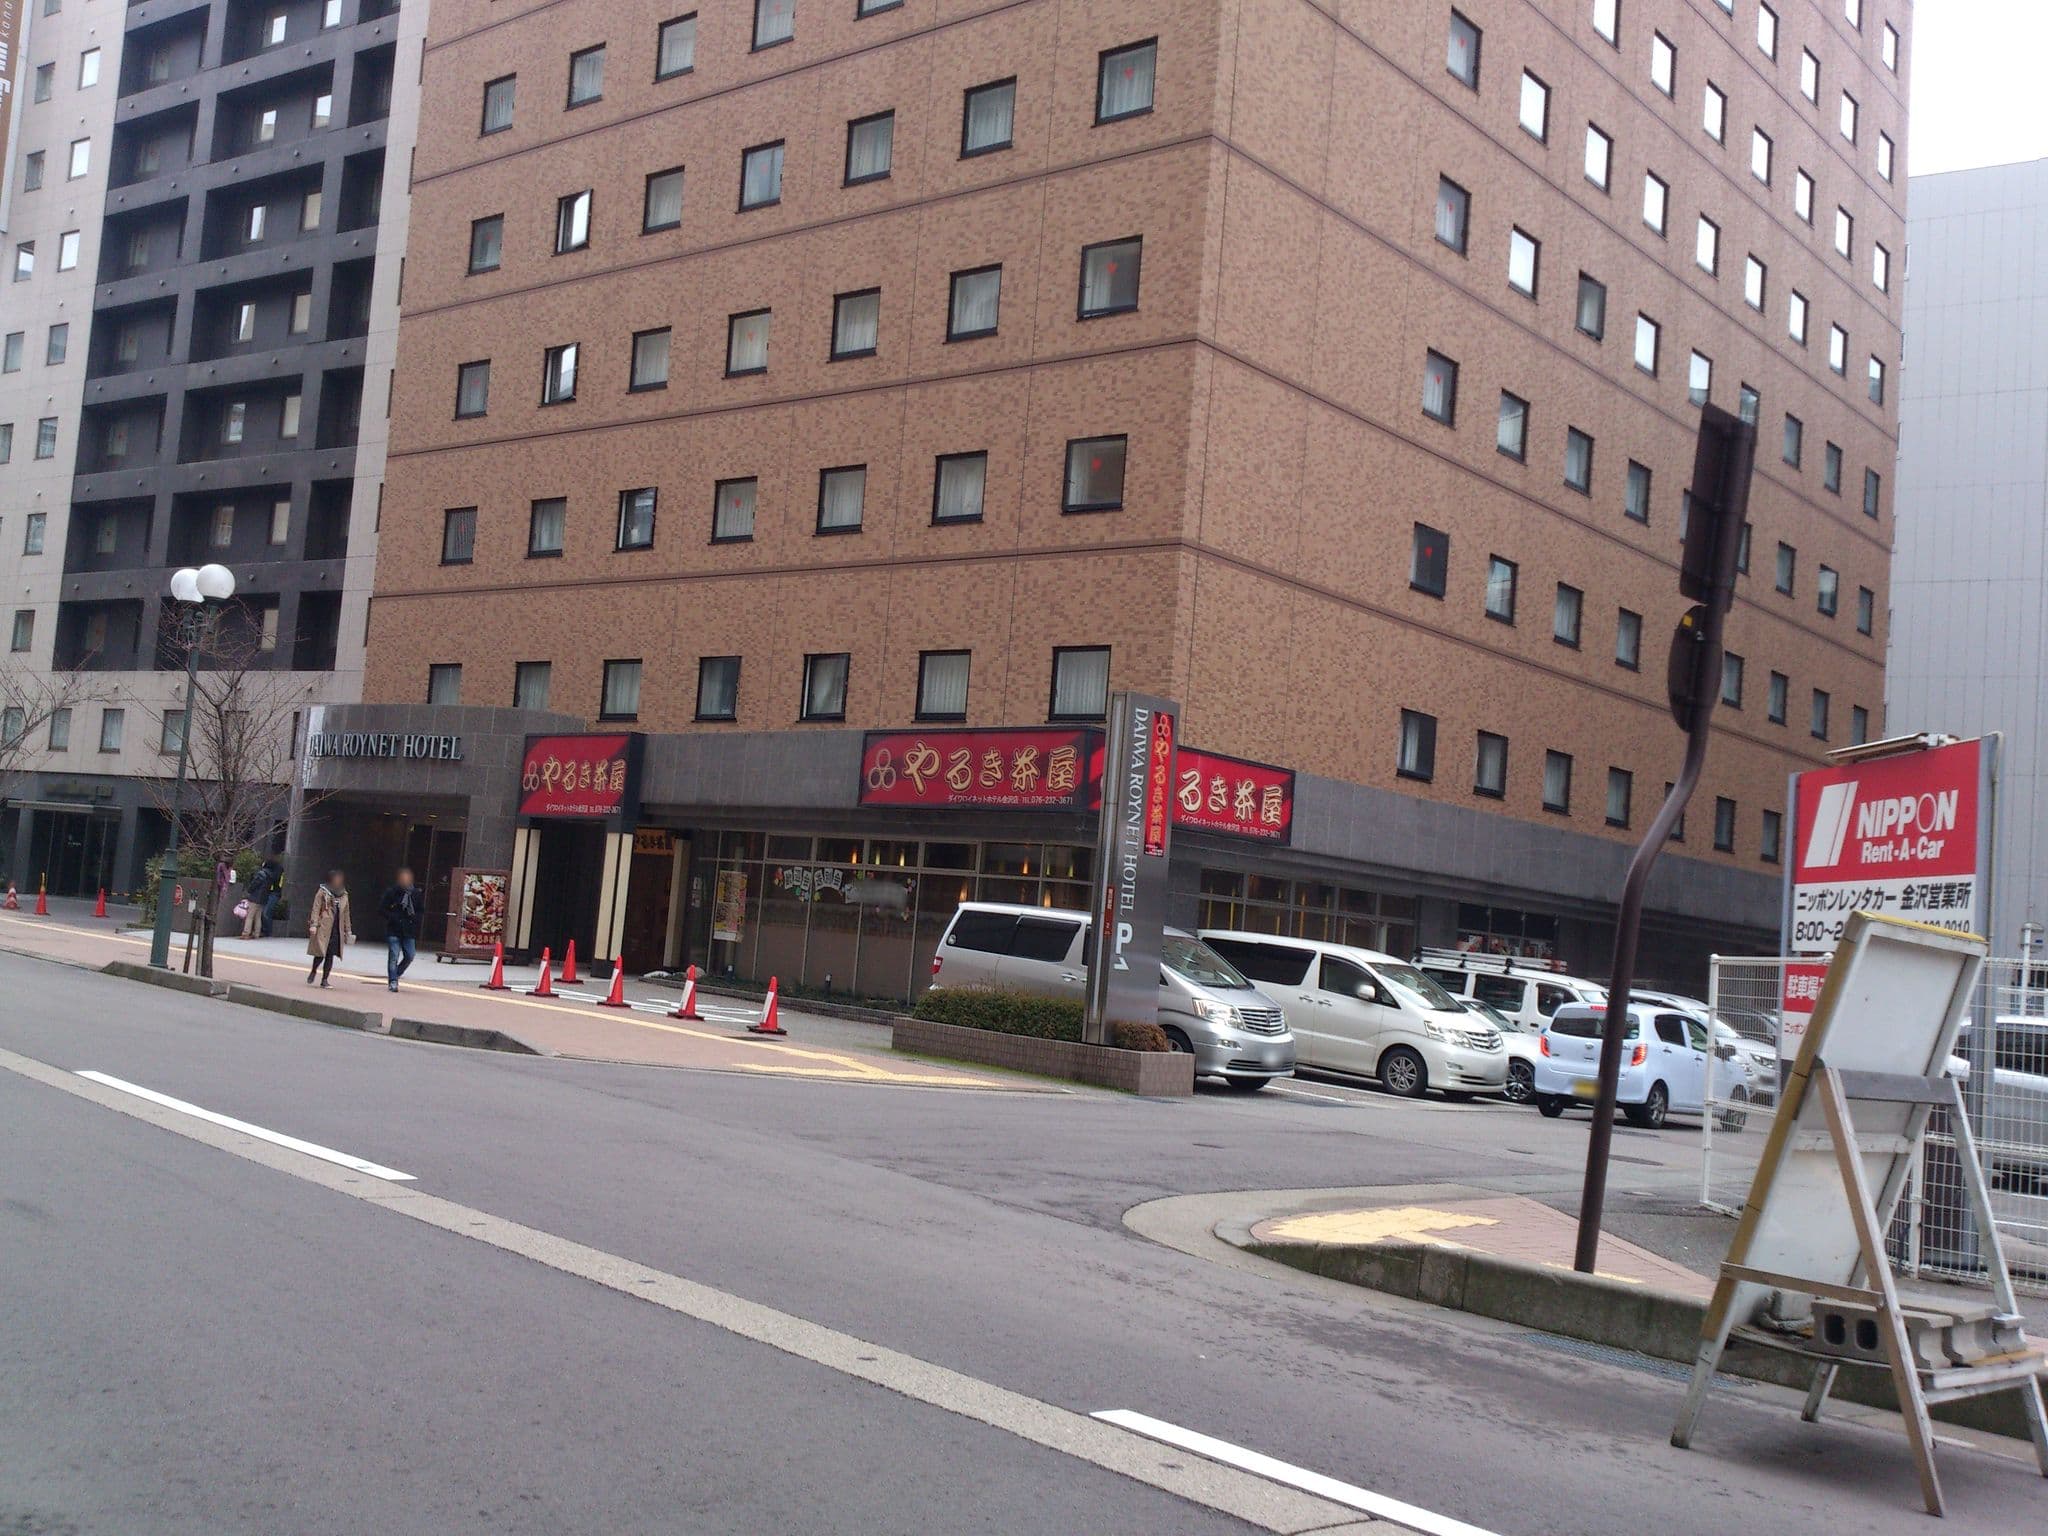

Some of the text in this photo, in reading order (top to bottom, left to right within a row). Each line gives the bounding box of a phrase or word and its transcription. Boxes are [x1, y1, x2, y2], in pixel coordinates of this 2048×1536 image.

[342, 733, 399, 758] ROYNET
[403, 734, 462, 760] HOTEL
[903, 740, 1077, 796] やるき茶屋
[542, 755, 626, 796] やるき茶屋
[1120, 707, 1149, 911] DAIWA ROYNET HOTEL
[1856, 789, 1959, 839] NIPPON
[1797, 881, 1972, 912] ニッポンレンタカー 金沢営業所
